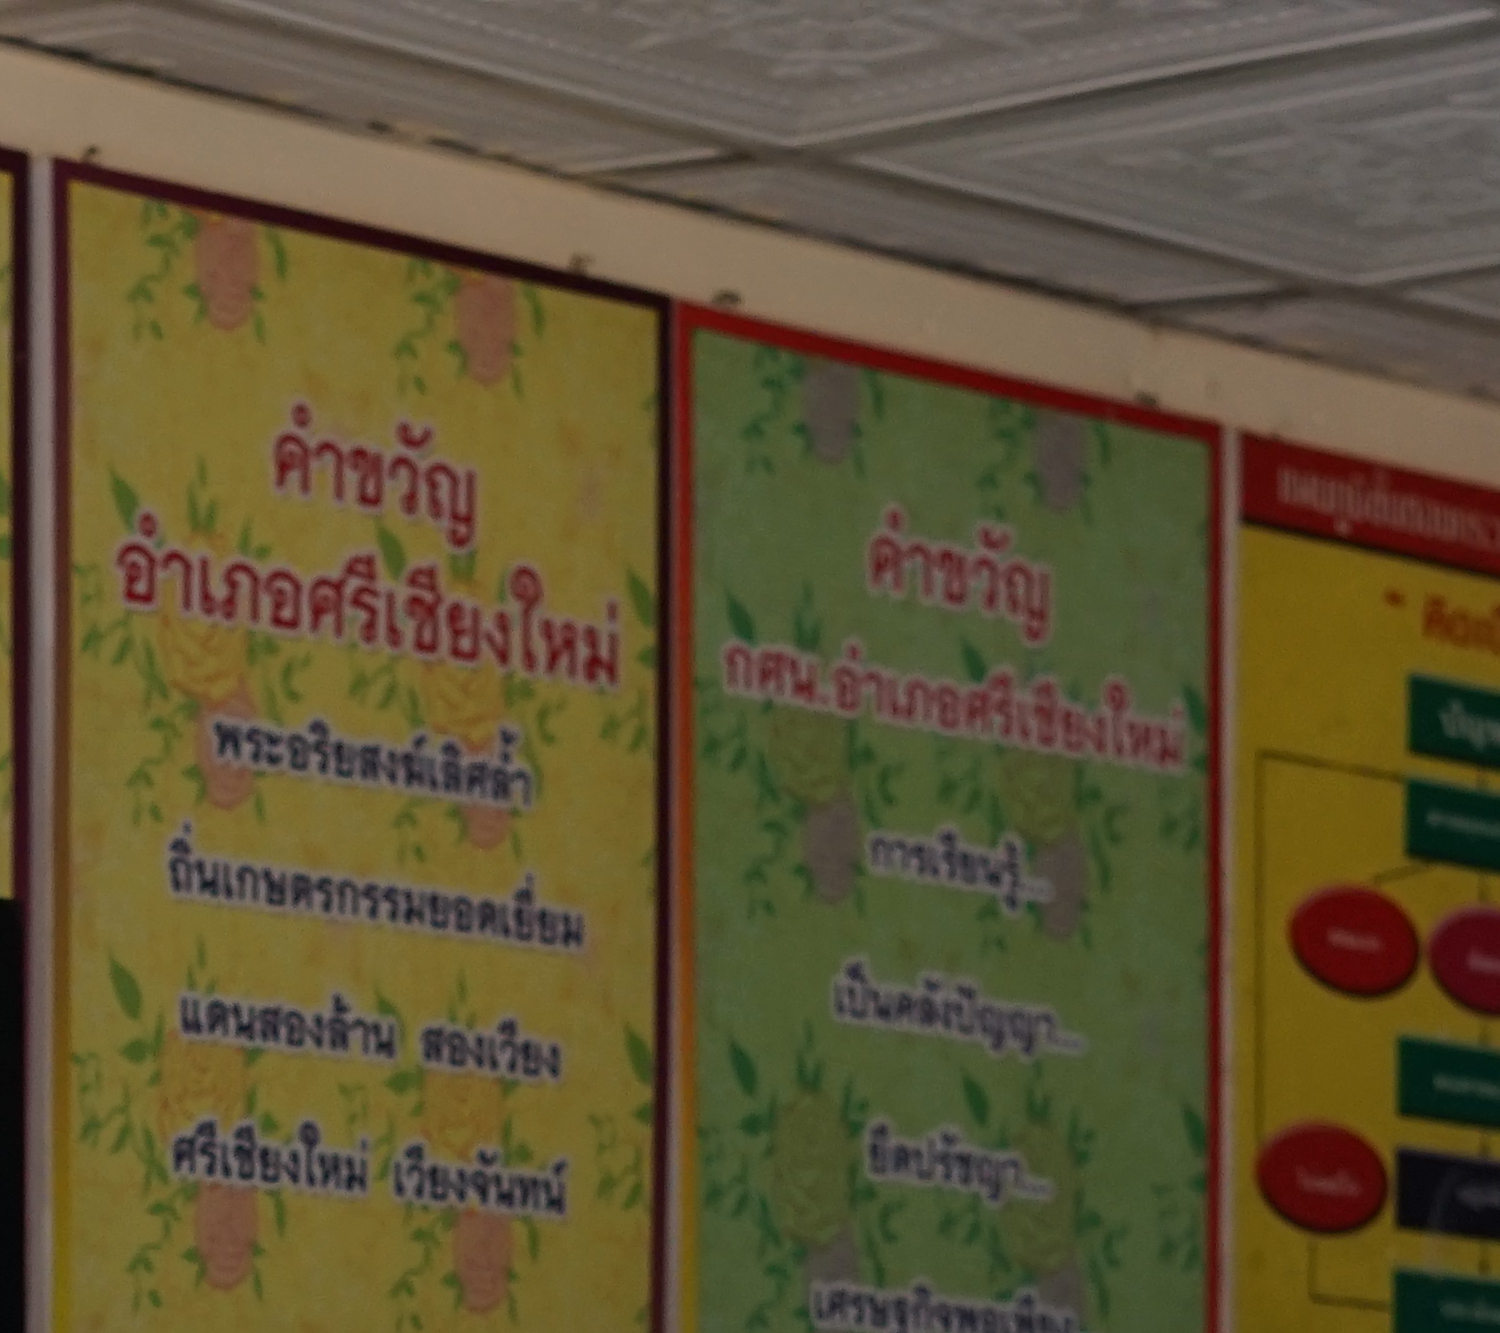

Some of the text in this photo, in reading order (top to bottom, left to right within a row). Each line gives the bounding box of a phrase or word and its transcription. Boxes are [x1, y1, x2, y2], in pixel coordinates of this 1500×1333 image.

[271, 402, 478, 551] คำขวัญ
[116, 512, 622, 688] อำเภอศรีเชียงใหม่
[867, 504, 1053, 646] คำขวัญ
[721, 639, 1187, 775] กศน.อำเภอศรีเชียงใหม่
[170, 1117, 568, 1217] ศรีเชียงใหม่ เวียงจันทน์
